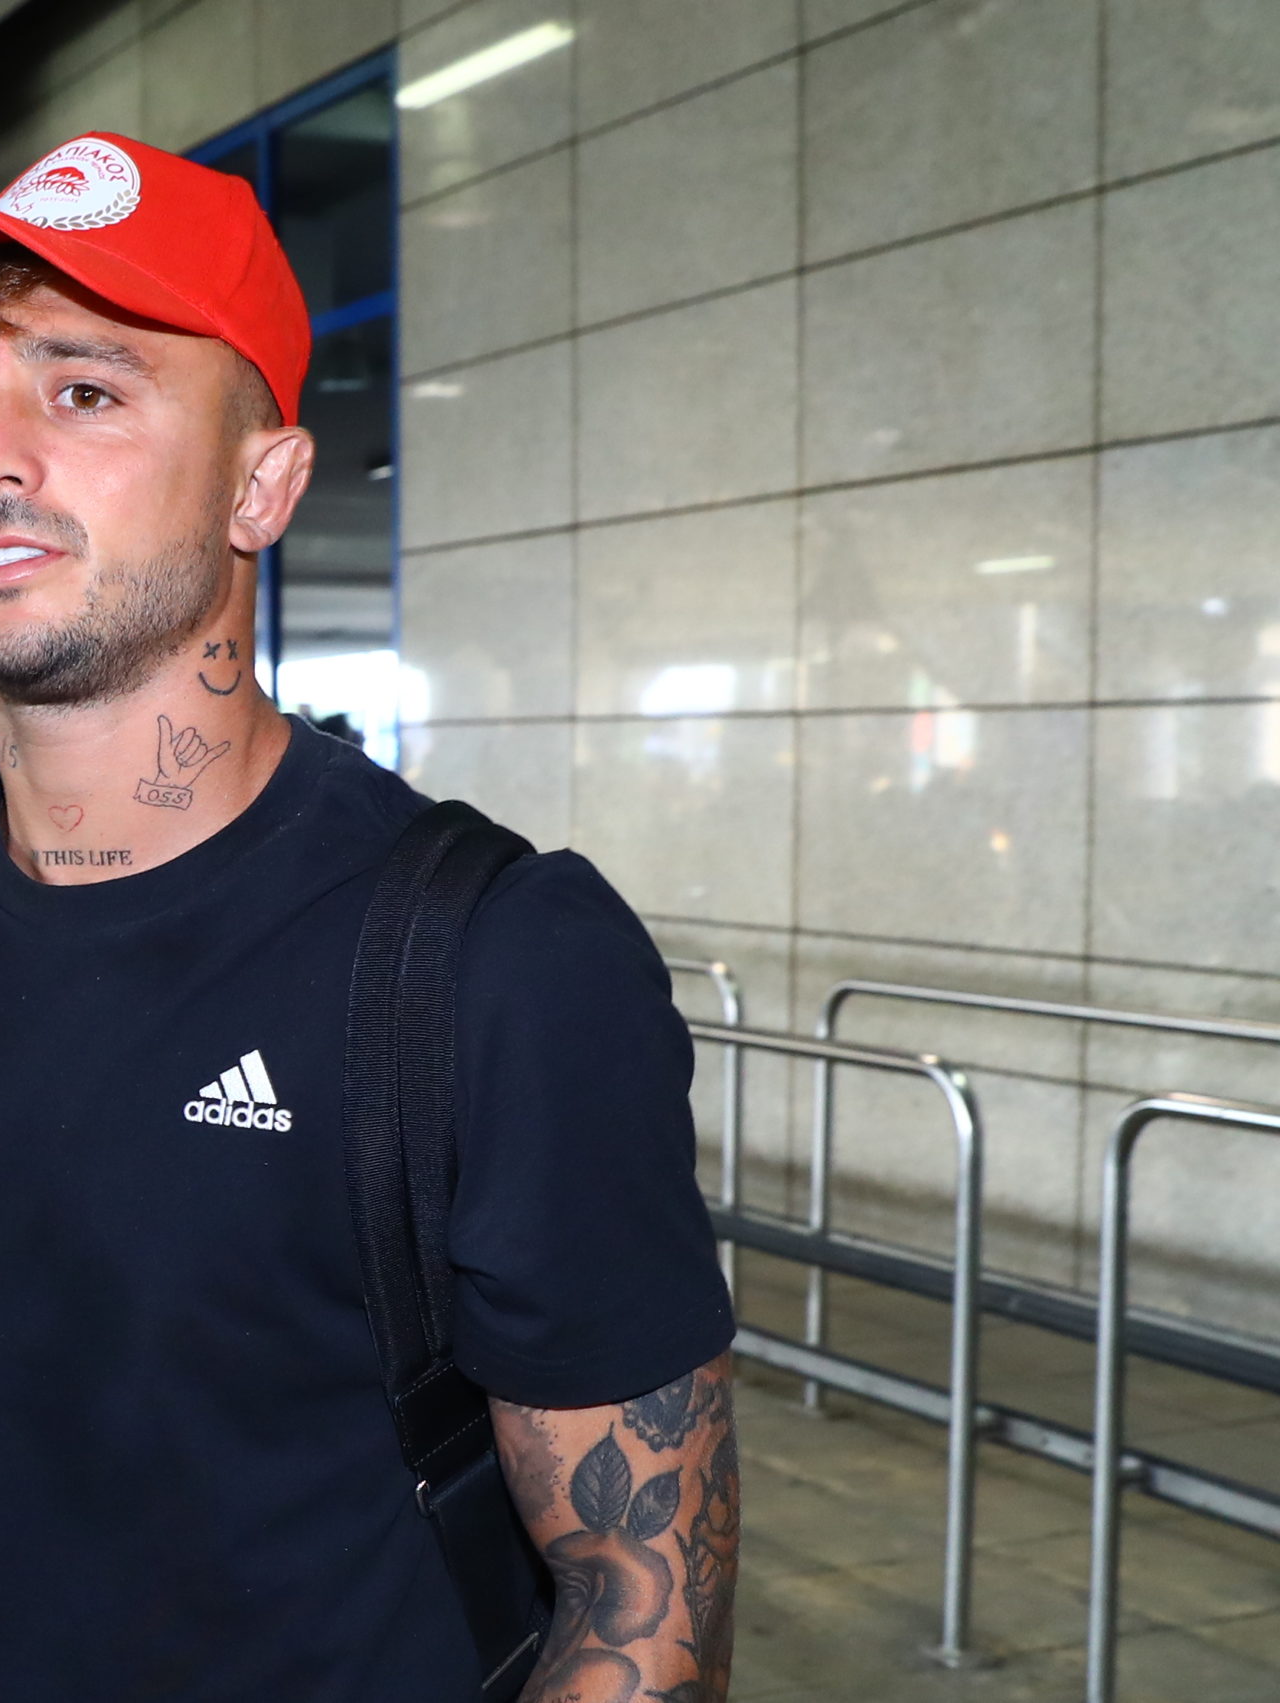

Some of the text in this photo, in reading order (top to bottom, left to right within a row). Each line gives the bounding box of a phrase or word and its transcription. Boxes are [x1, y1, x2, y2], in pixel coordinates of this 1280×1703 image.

[147, 789, 187, 804] OSS
[43, 850, 85, 867] THIS
[90, 850, 133, 867] LIFE
[183, 1098, 293, 1132] adidas
